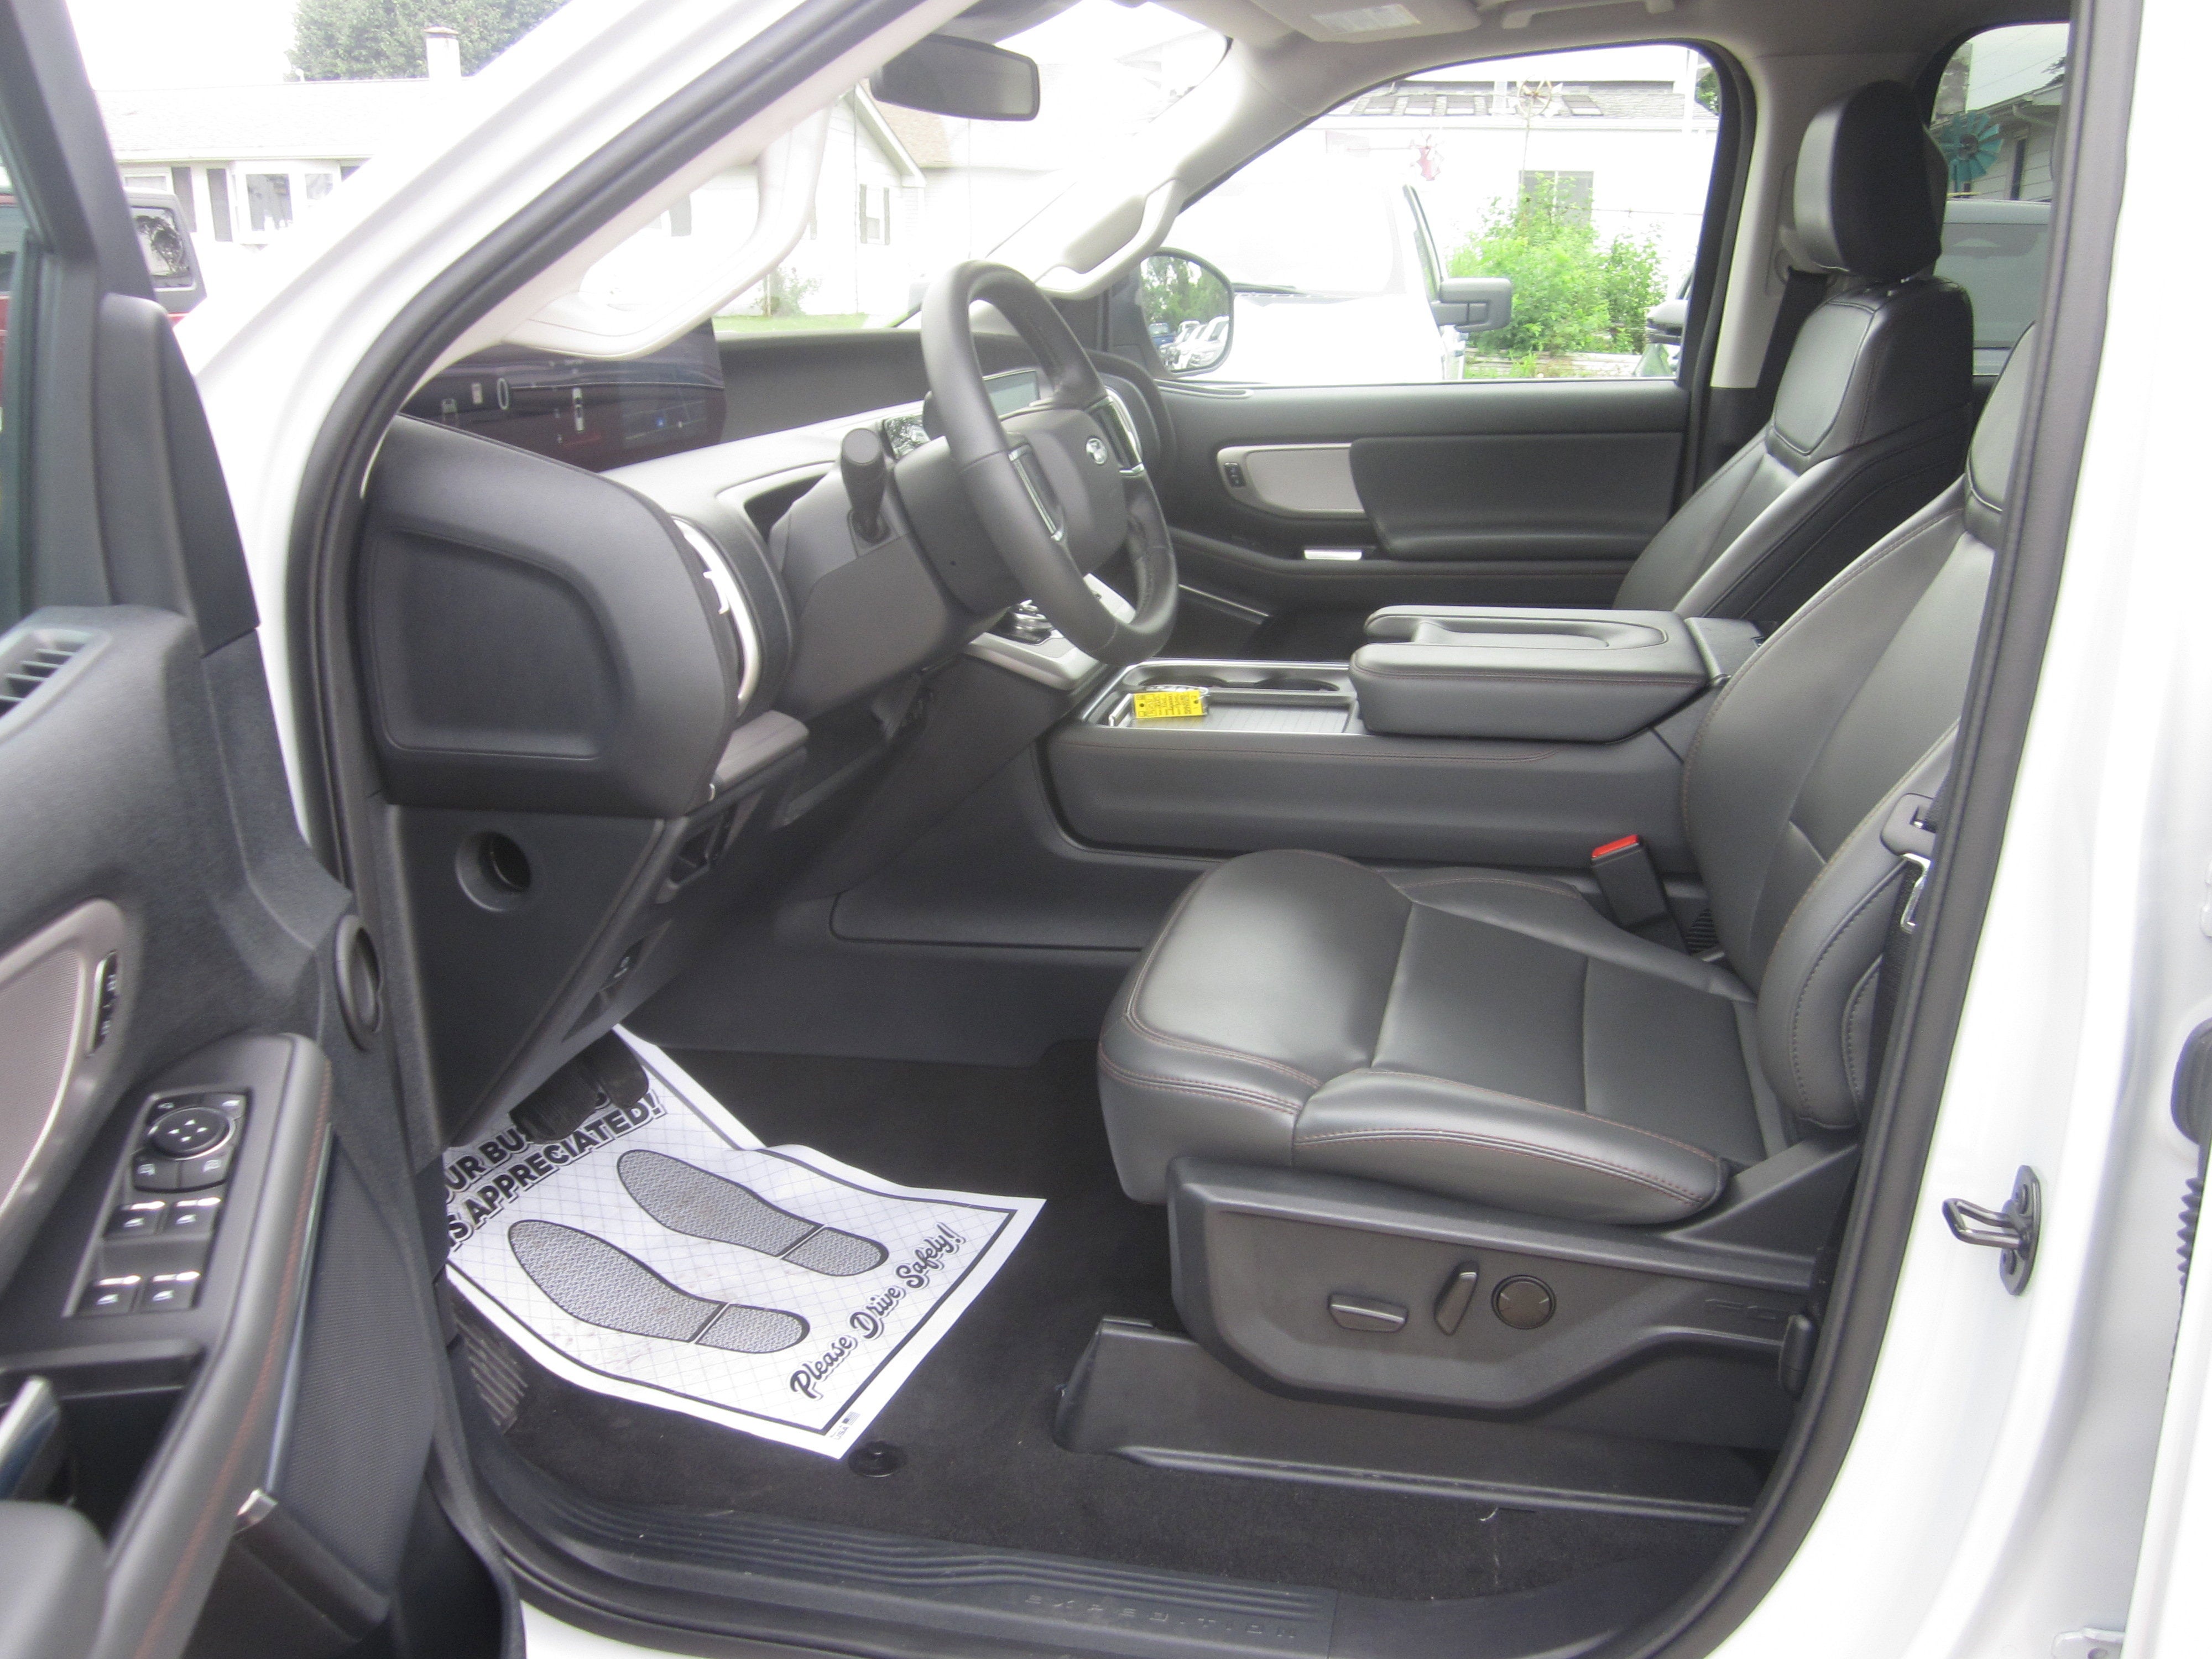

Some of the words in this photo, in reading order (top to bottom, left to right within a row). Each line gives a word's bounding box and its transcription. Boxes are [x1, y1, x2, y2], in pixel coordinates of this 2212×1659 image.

[441, 1155, 488, 1199] UR
[444, 1214, 469, 1249] S
[464, 1092, 665, 1226] APPRECIATED!
[790, 1336, 854, 1400] Please
[850, 1286, 902, 1339] Drive
[895, 1223, 962, 1289] Safely!
